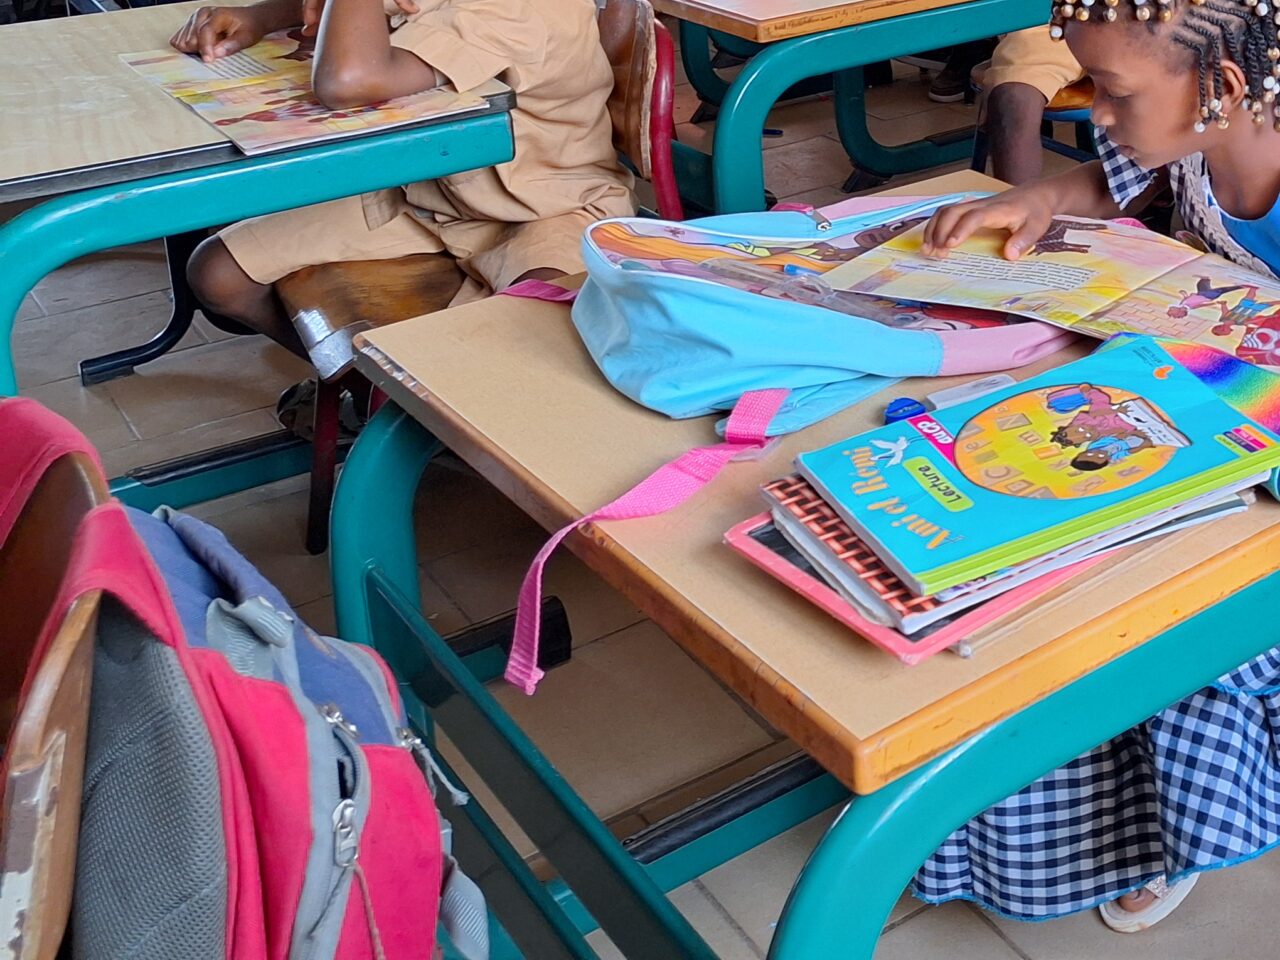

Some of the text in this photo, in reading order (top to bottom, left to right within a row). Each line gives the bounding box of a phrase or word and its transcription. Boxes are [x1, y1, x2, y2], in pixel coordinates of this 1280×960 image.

[918, 464, 962, 504] Lecture
[867, 497, 908, 515] et
[891, 514, 964, 550] Ami
